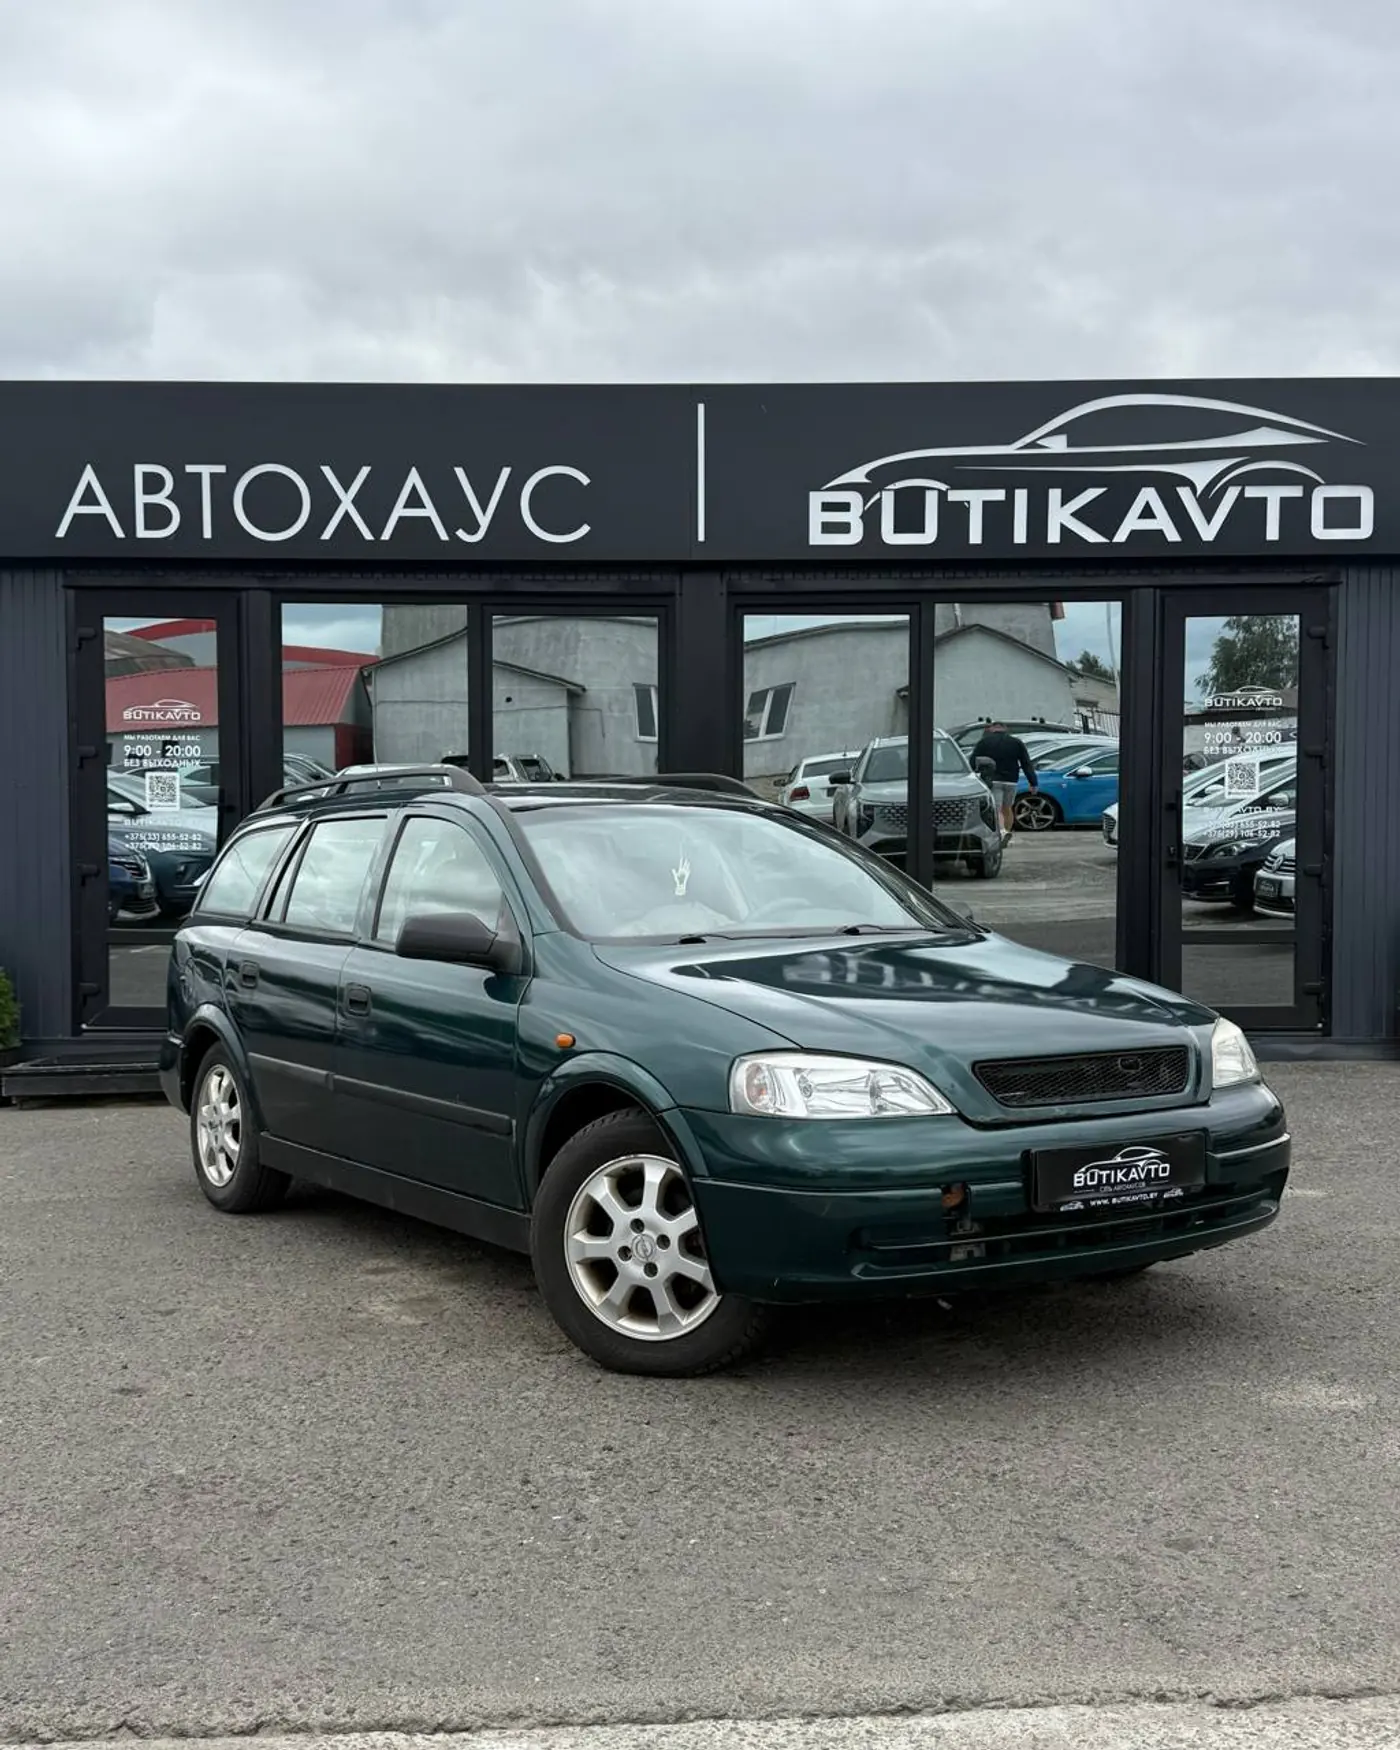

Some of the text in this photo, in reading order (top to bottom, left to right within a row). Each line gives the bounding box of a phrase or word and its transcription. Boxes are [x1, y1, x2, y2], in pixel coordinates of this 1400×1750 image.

[55, 463, 591, 543] АВТОХАУС
[808, 484, 1374, 546] BUTIKAVTO
[1204, 697, 1283, 707] BUTIKAVTO
[123, 710, 201, 720] BUTIKAVTO
[1204, 732, 1232, 743] 9:00
[1245, 732, 1282, 743] 20:00
[124, 745, 152, 756] 9:00
[165, 745, 201, 757] 20:00
[124, 759, 201, 768] БЕЗ ВЫХОДНЫХ
[1073, 1163, 1170, 1187] BUTIKAVTO
